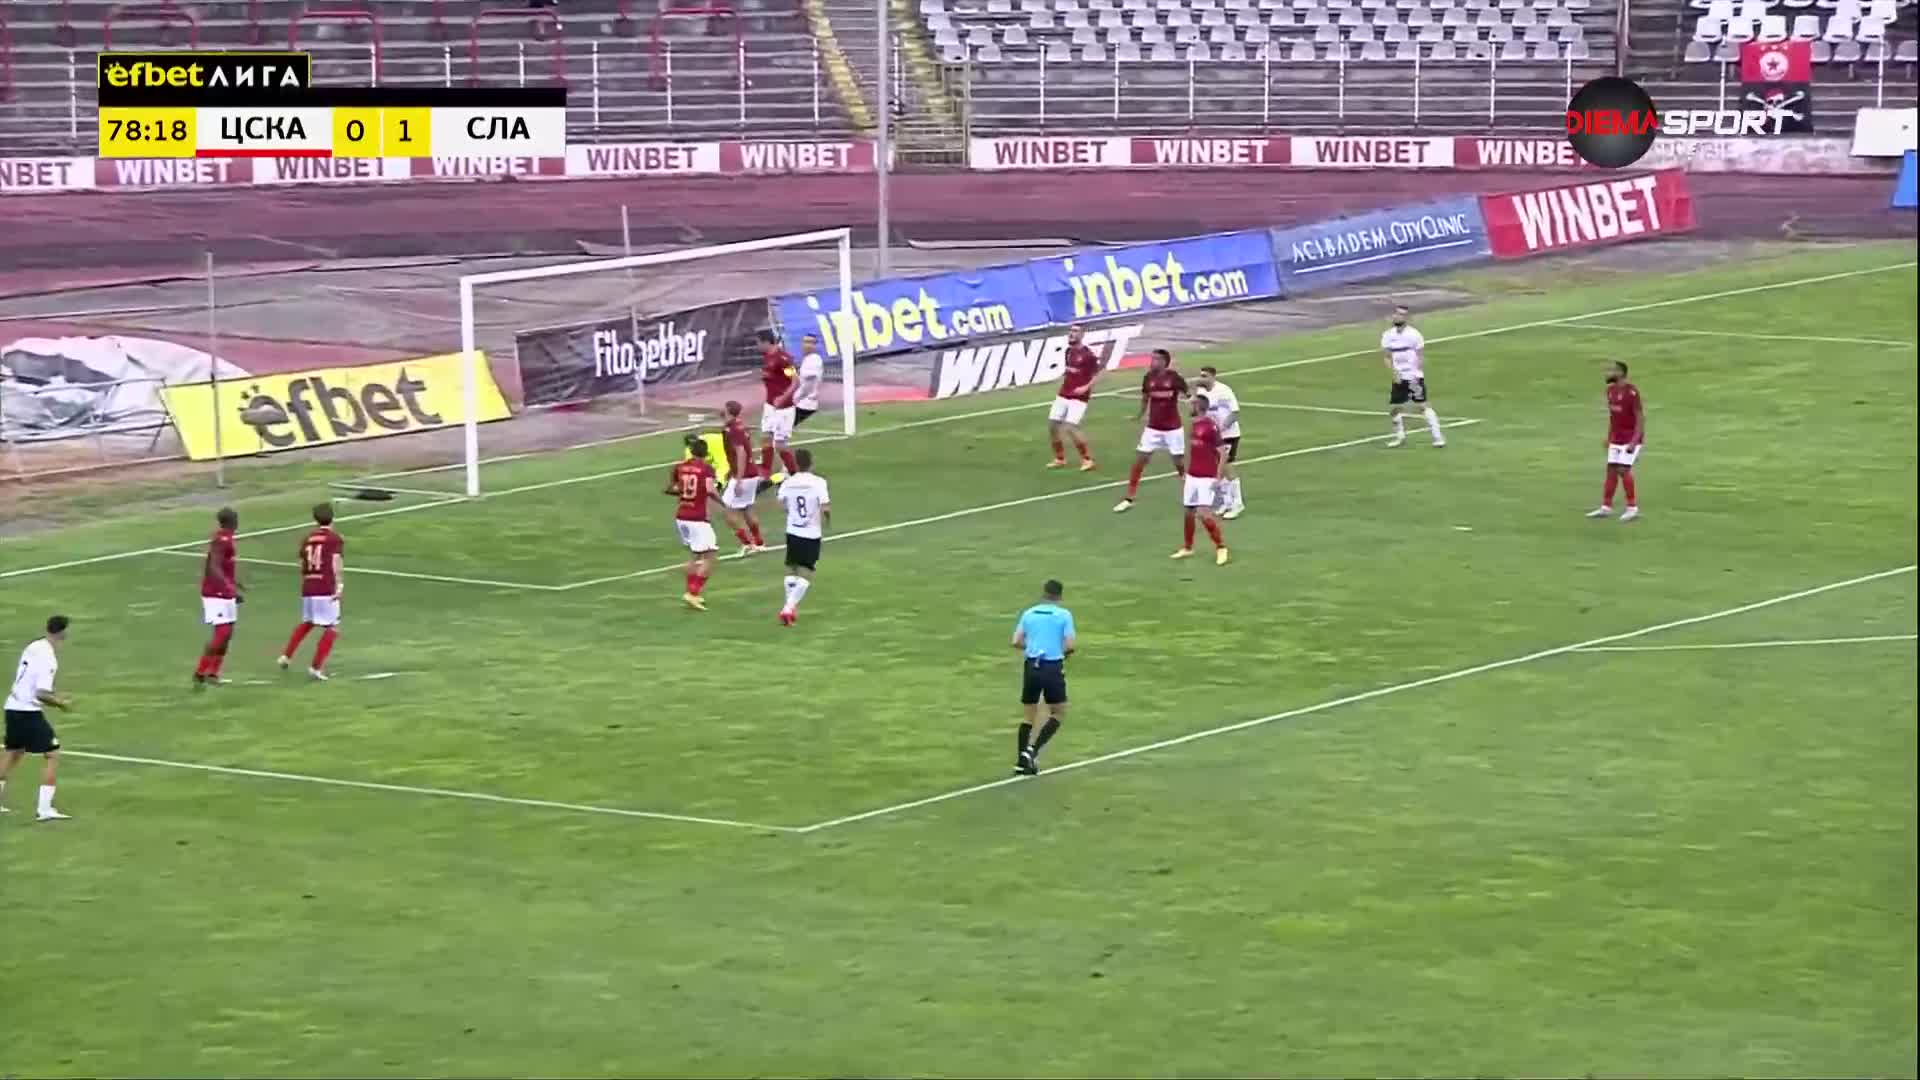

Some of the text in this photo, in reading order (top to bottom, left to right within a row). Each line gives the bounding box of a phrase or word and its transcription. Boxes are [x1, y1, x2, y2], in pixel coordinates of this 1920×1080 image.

[586, 147, 698, 171] WINBET
[740, 143, 853, 168] WINBET
[994, 140, 1108, 164] WINBET
[1153, 139, 1269, 164] WINBET
[1315, 141, 1430, 163] WINBET
[1476, 139, 1586, 166] WINBE
[0, 162, 72, 186] NBET
[115, 158, 233, 184] WINBET
[1512, 175, 1662, 250] WINBET
[1065, 250, 1248, 318] inbet.com
[806, 287, 1014, 356] inbet.com
[679, 473, 699, 499] 19
[796, 495, 808, 518] 8
[305, 544, 323, 571] 14
